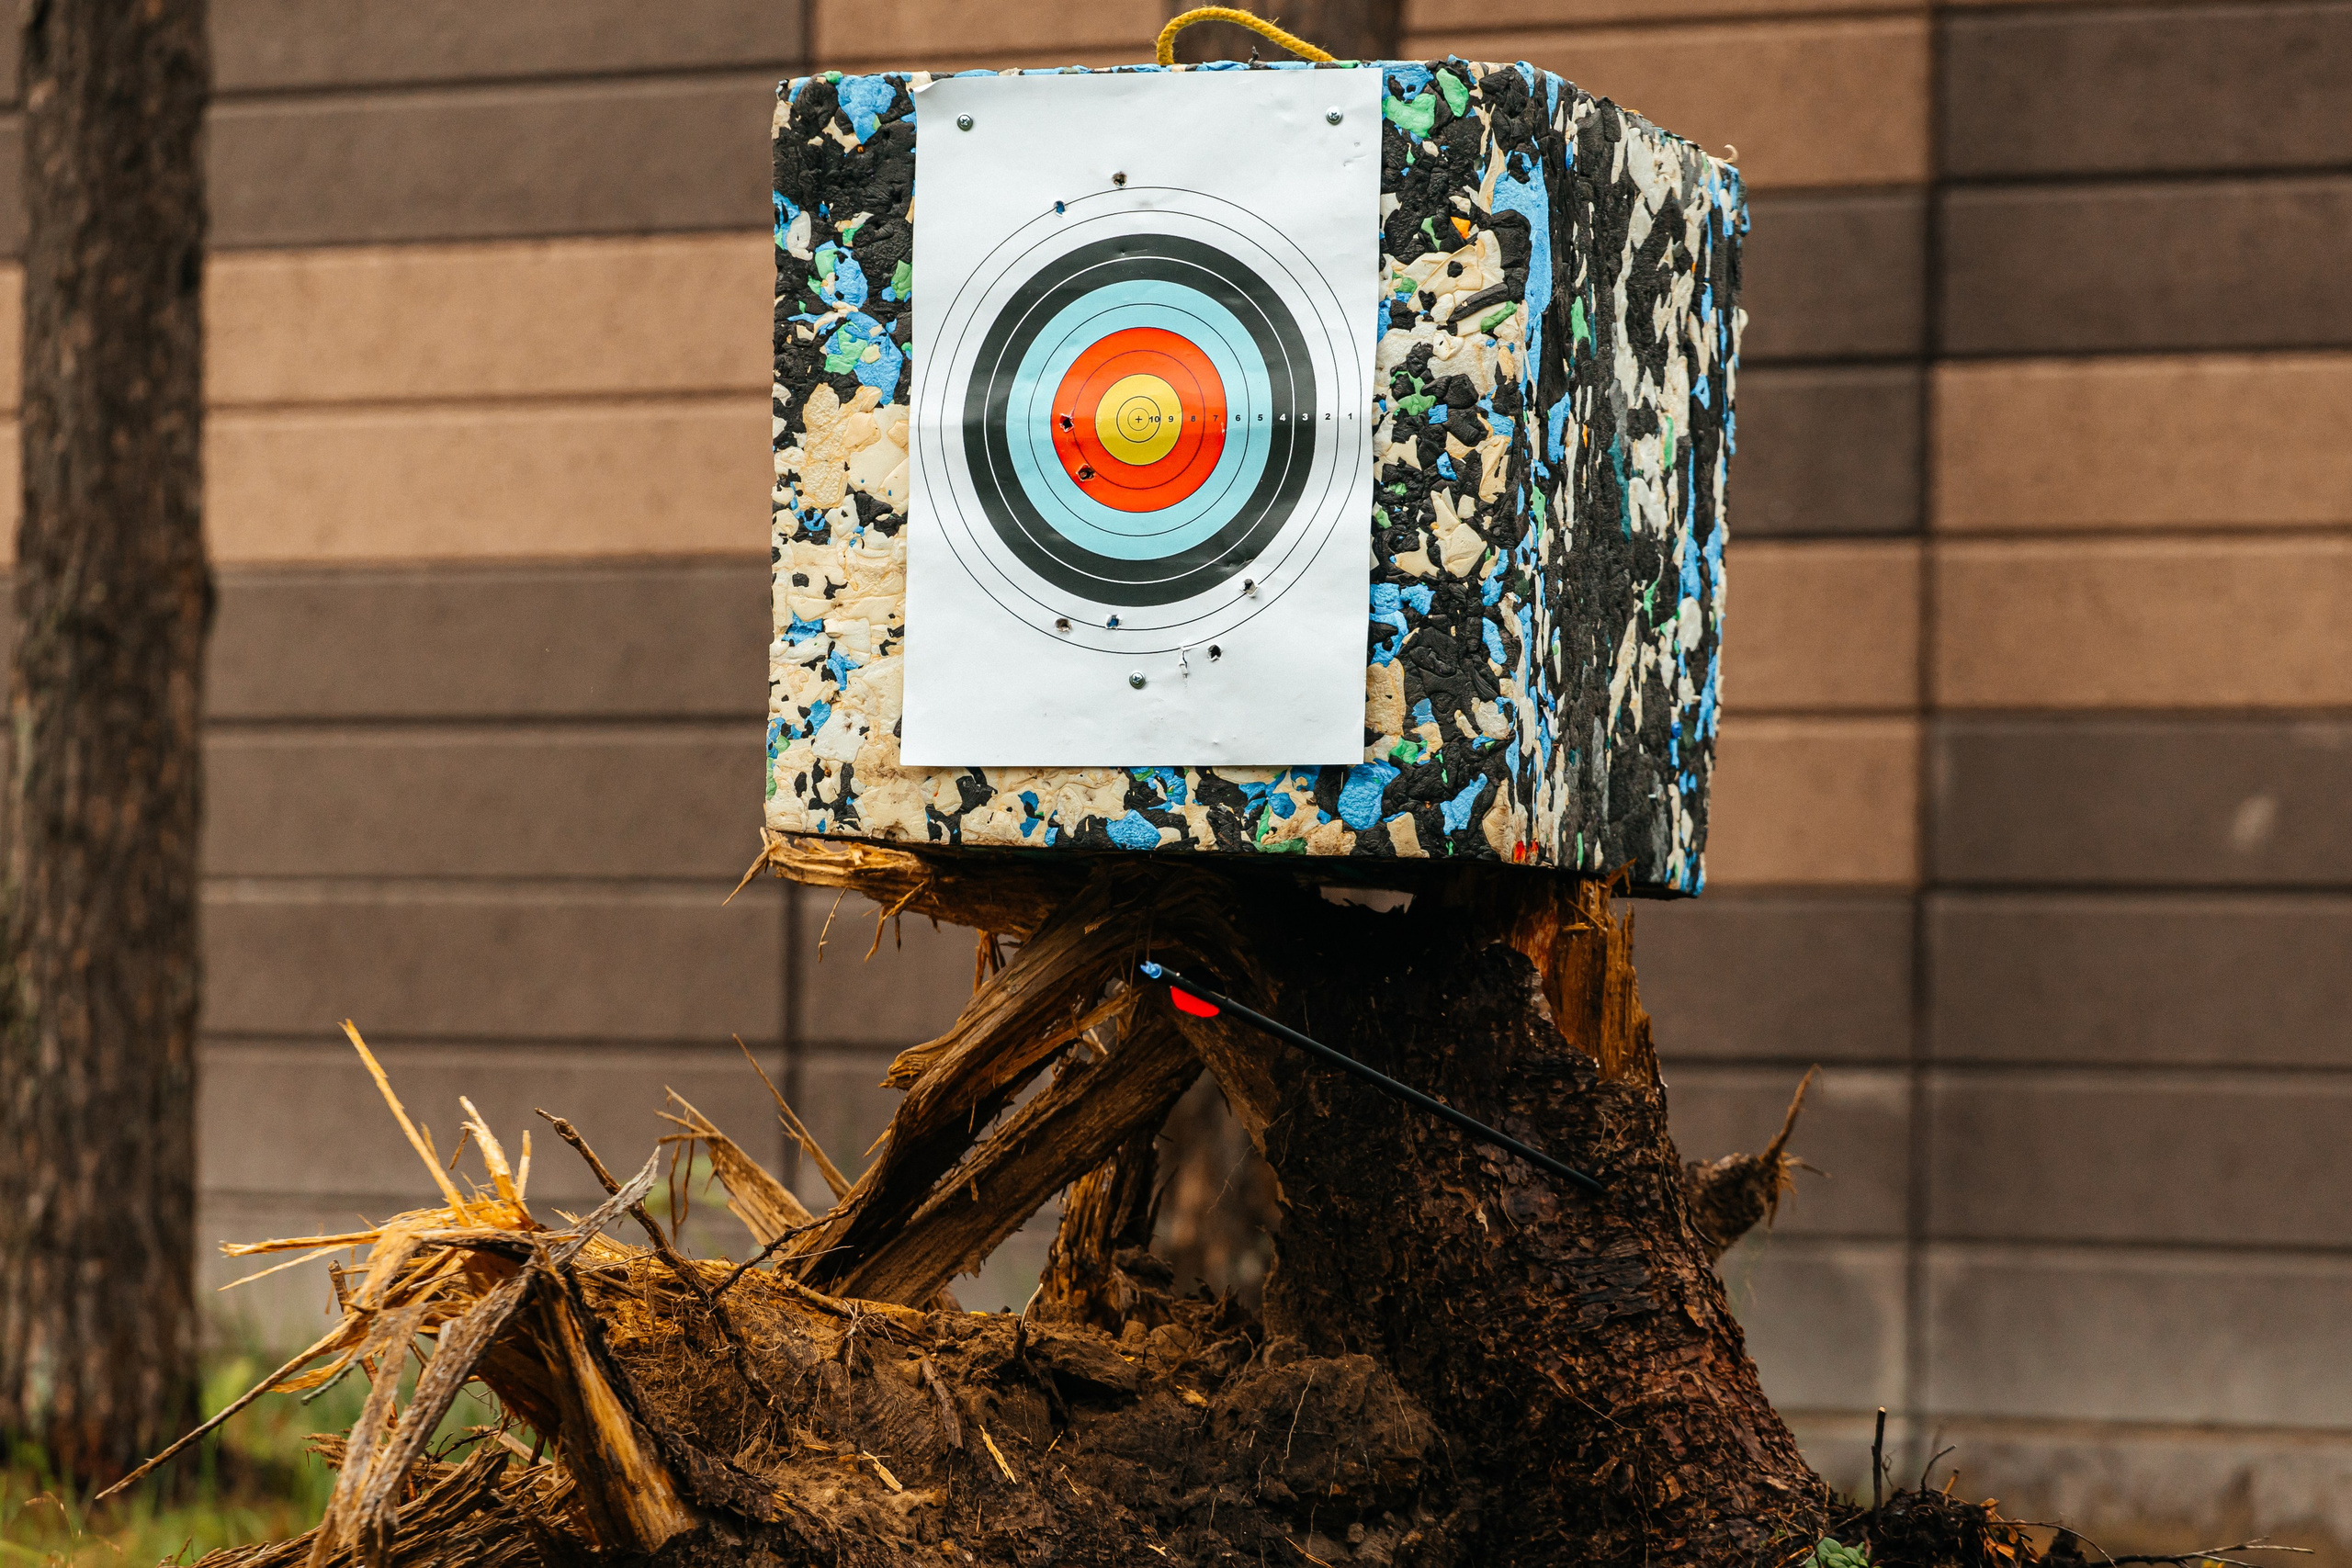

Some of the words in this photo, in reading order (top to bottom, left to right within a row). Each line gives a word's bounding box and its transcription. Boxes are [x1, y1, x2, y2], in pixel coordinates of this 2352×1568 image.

[1148, 415, 1160, 423] 10
[1257, 413, 1263, 422] 5
[1279, 413, 1286, 422] 4
[1302, 412, 1309, 421] 3
[1325, 412, 1331, 421] 2
